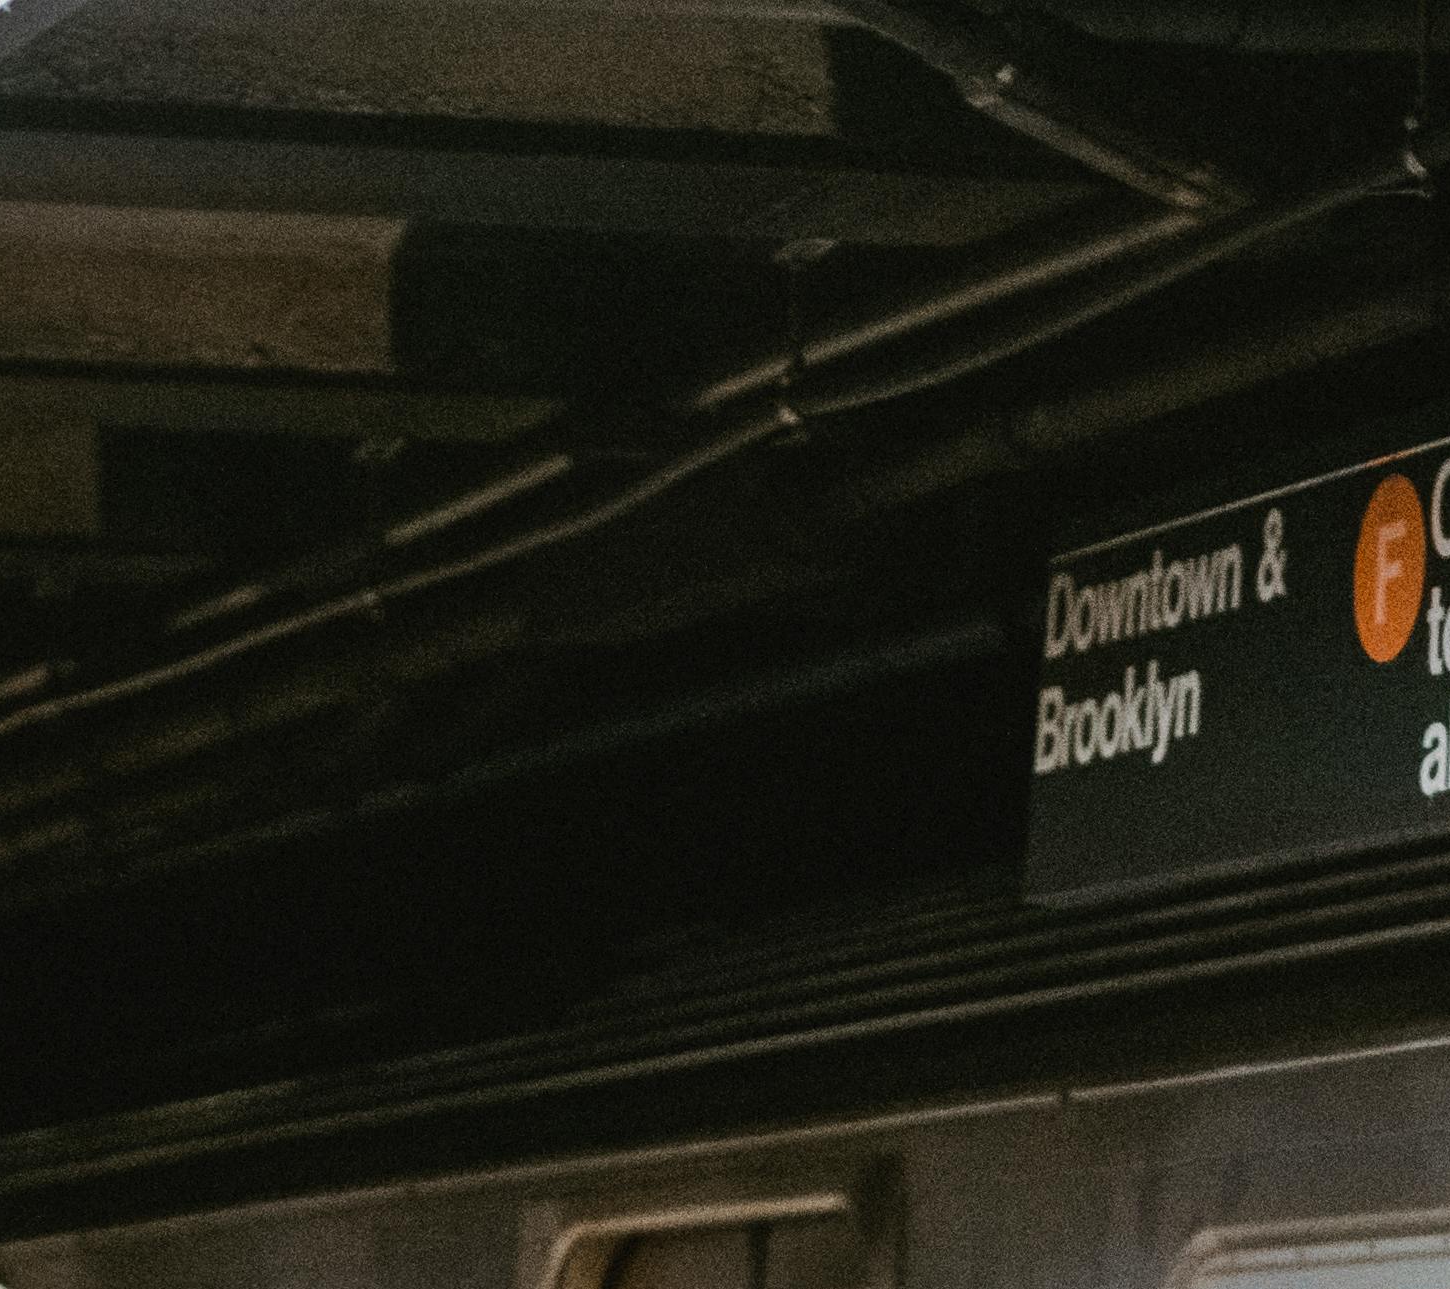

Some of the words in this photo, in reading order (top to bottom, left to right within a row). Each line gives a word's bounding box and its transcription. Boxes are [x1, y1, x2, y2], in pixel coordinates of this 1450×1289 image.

[1045, 544, 1243, 659] Downtown
[1256, 507, 1287, 602] &
[1034, 660, 1203, 773] Brooklyn
